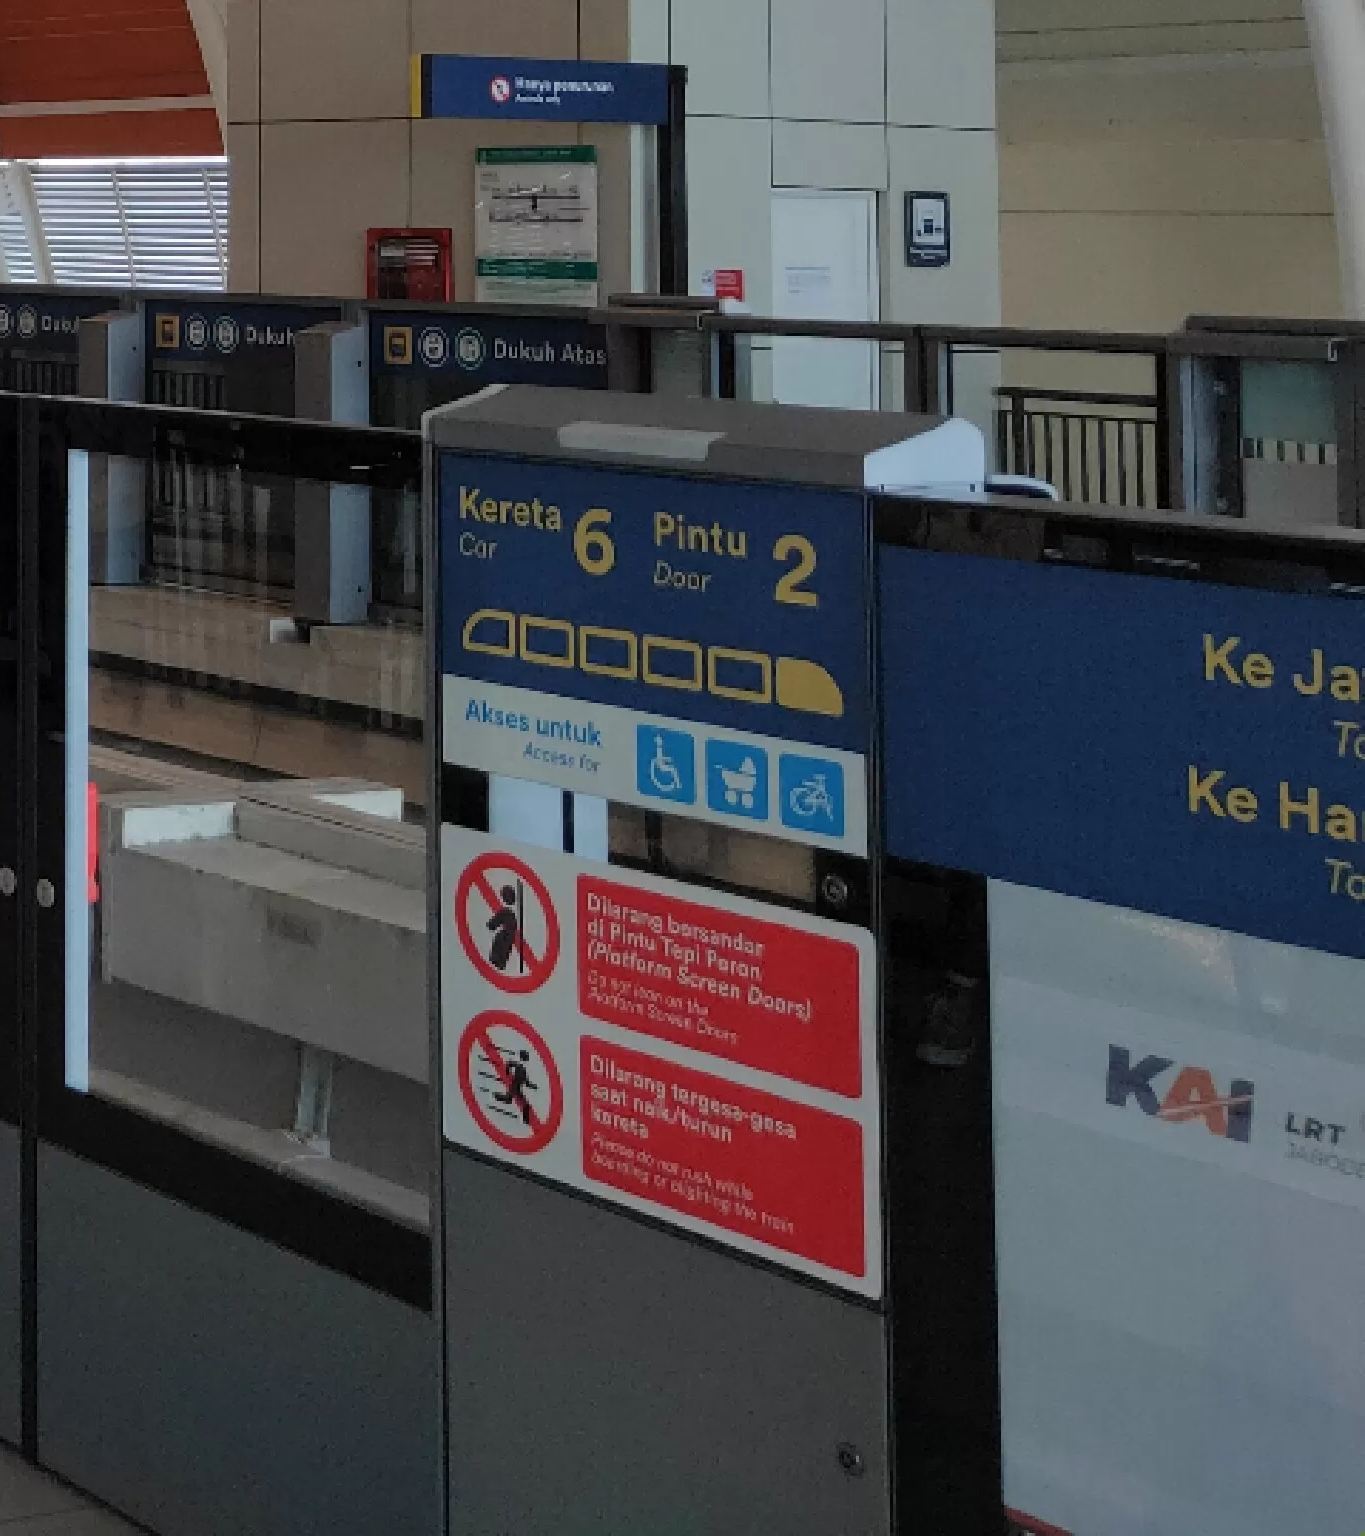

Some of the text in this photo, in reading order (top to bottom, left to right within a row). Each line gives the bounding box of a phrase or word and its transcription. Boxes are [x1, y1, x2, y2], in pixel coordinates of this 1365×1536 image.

[494, 337, 607, 366] Dukuh Atas
[458, 485, 818, 607] Kereta 6 Pintu 2
[458, 532, 712, 592] Car Door
[1203, 633, 1365, 704] Ke Ja
[464, 697, 603, 749] Akses untuk
[1188, 765, 1365, 843] Ke Ha
[587, 893, 664, 934] Dilarang
[587, 919, 603, 937] di
[610, 922, 656, 952] Pintu
[660, 935, 700, 964] Tepi
[587, 940, 812, 1024] (Platform Screen Doors)
[590, 1083, 627, 1108] saat
[590, 1054, 797, 1141] Dilarang tergesa-gesa
[1106, 1043, 1346, 1146] KAI LRT
